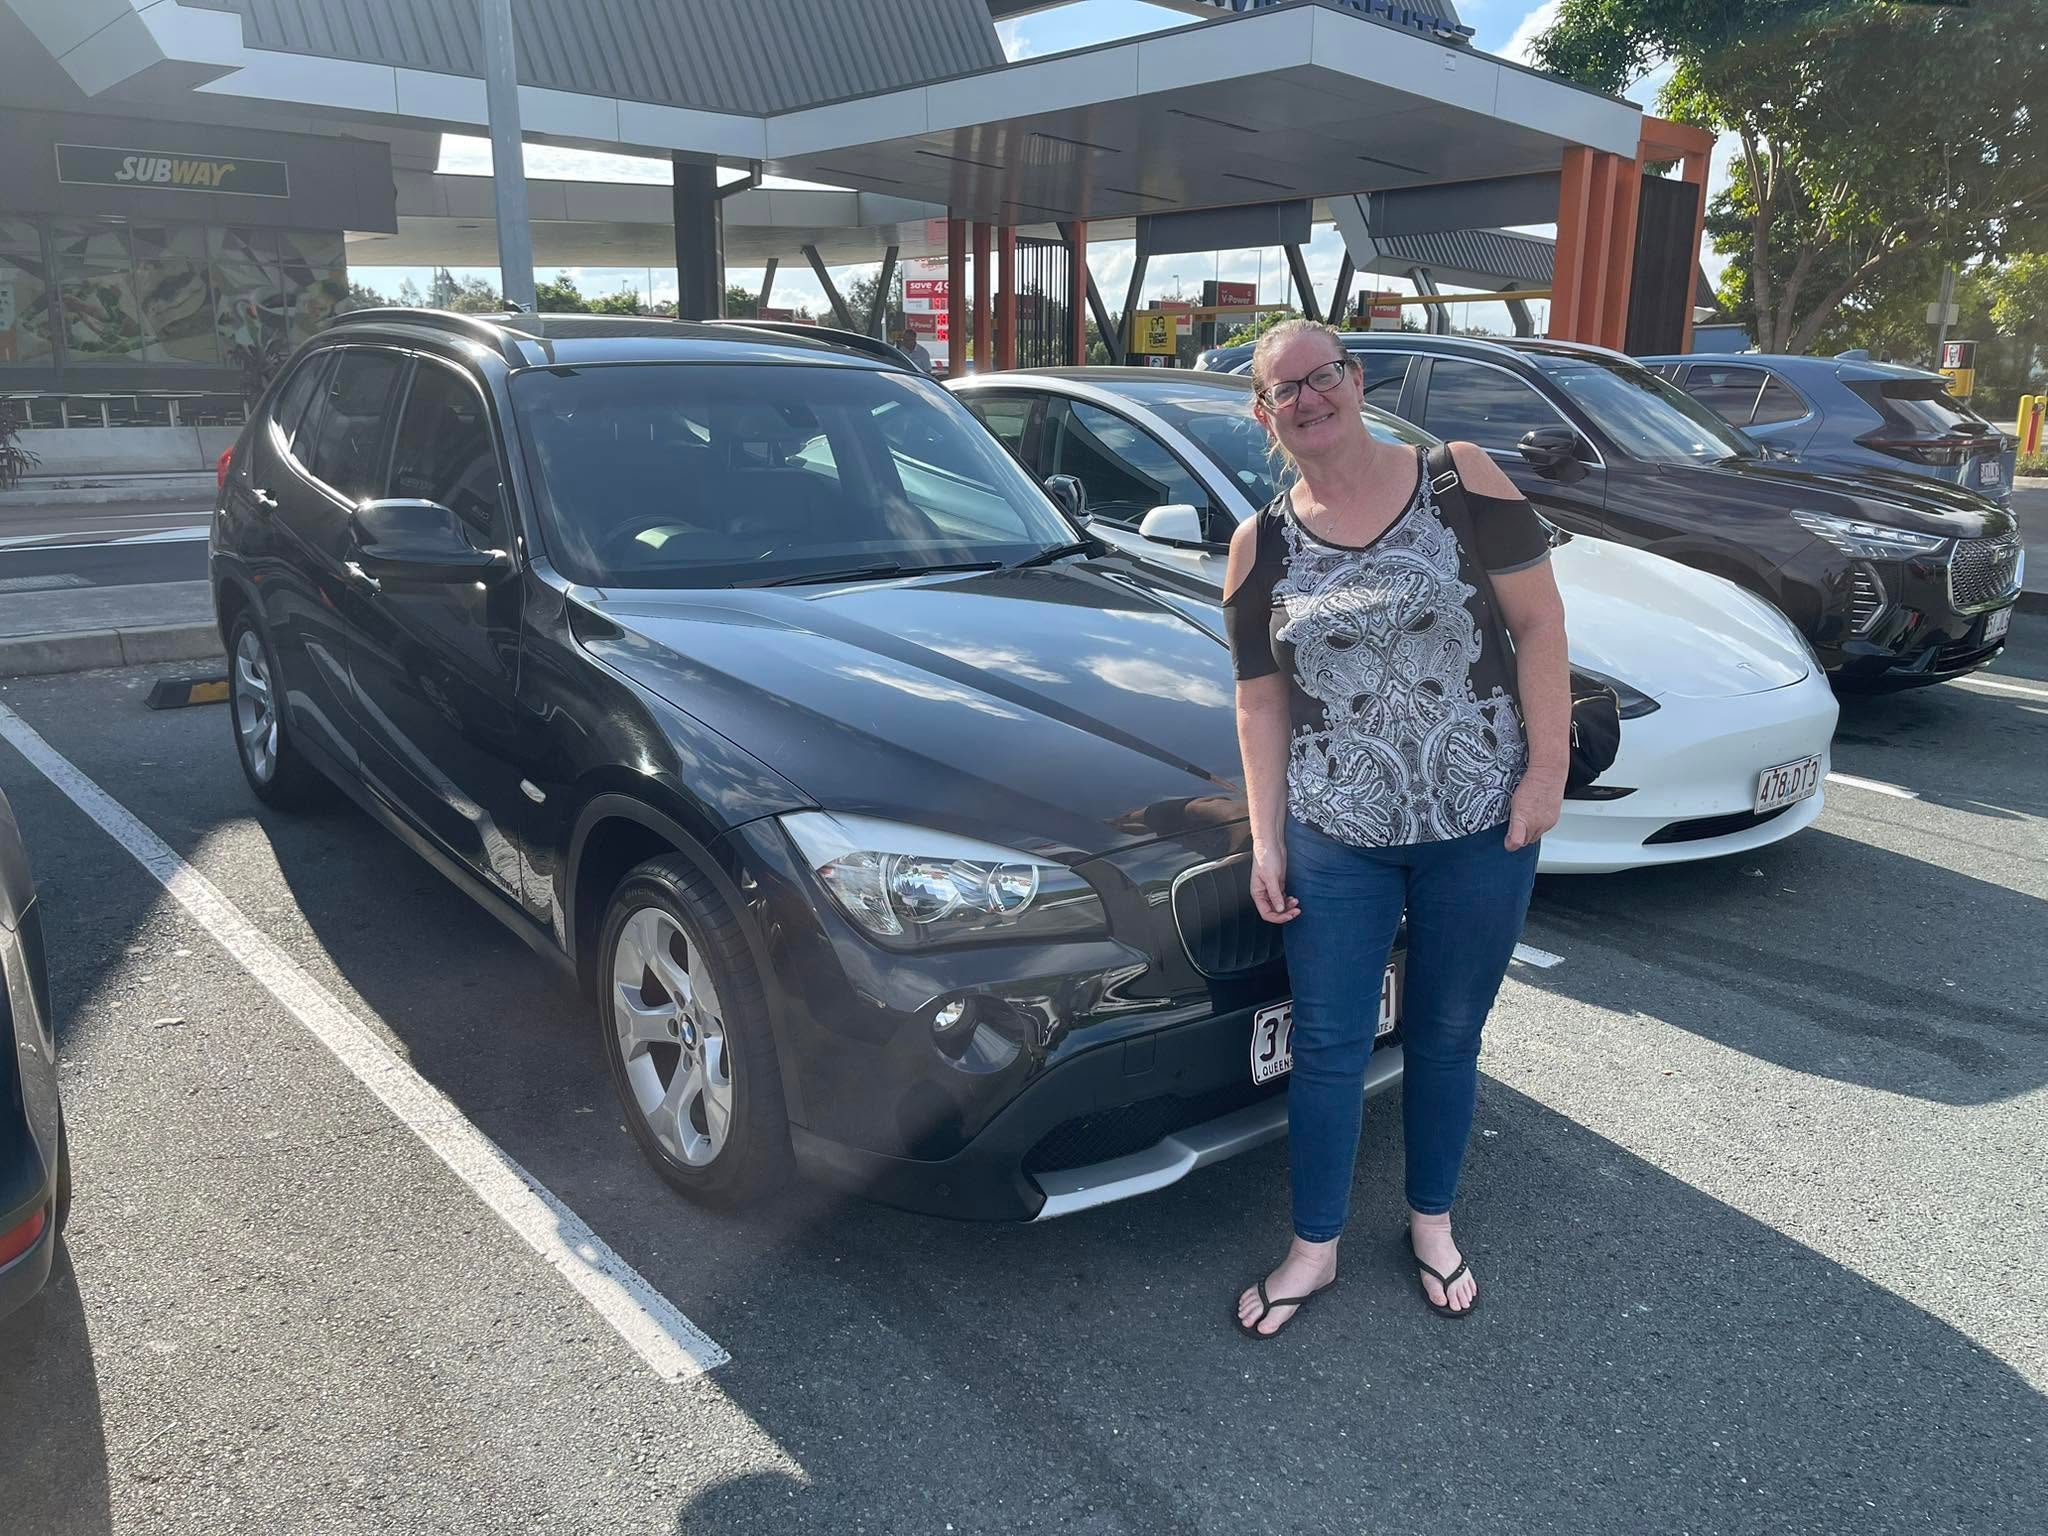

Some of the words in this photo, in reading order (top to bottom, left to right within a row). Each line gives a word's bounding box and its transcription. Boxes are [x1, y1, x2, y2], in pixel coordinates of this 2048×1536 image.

[114, 156, 236, 187] SUBWAY
[910, 281, 932, 290] save
[1263, 1057, 1294, 1076] QUEENS
